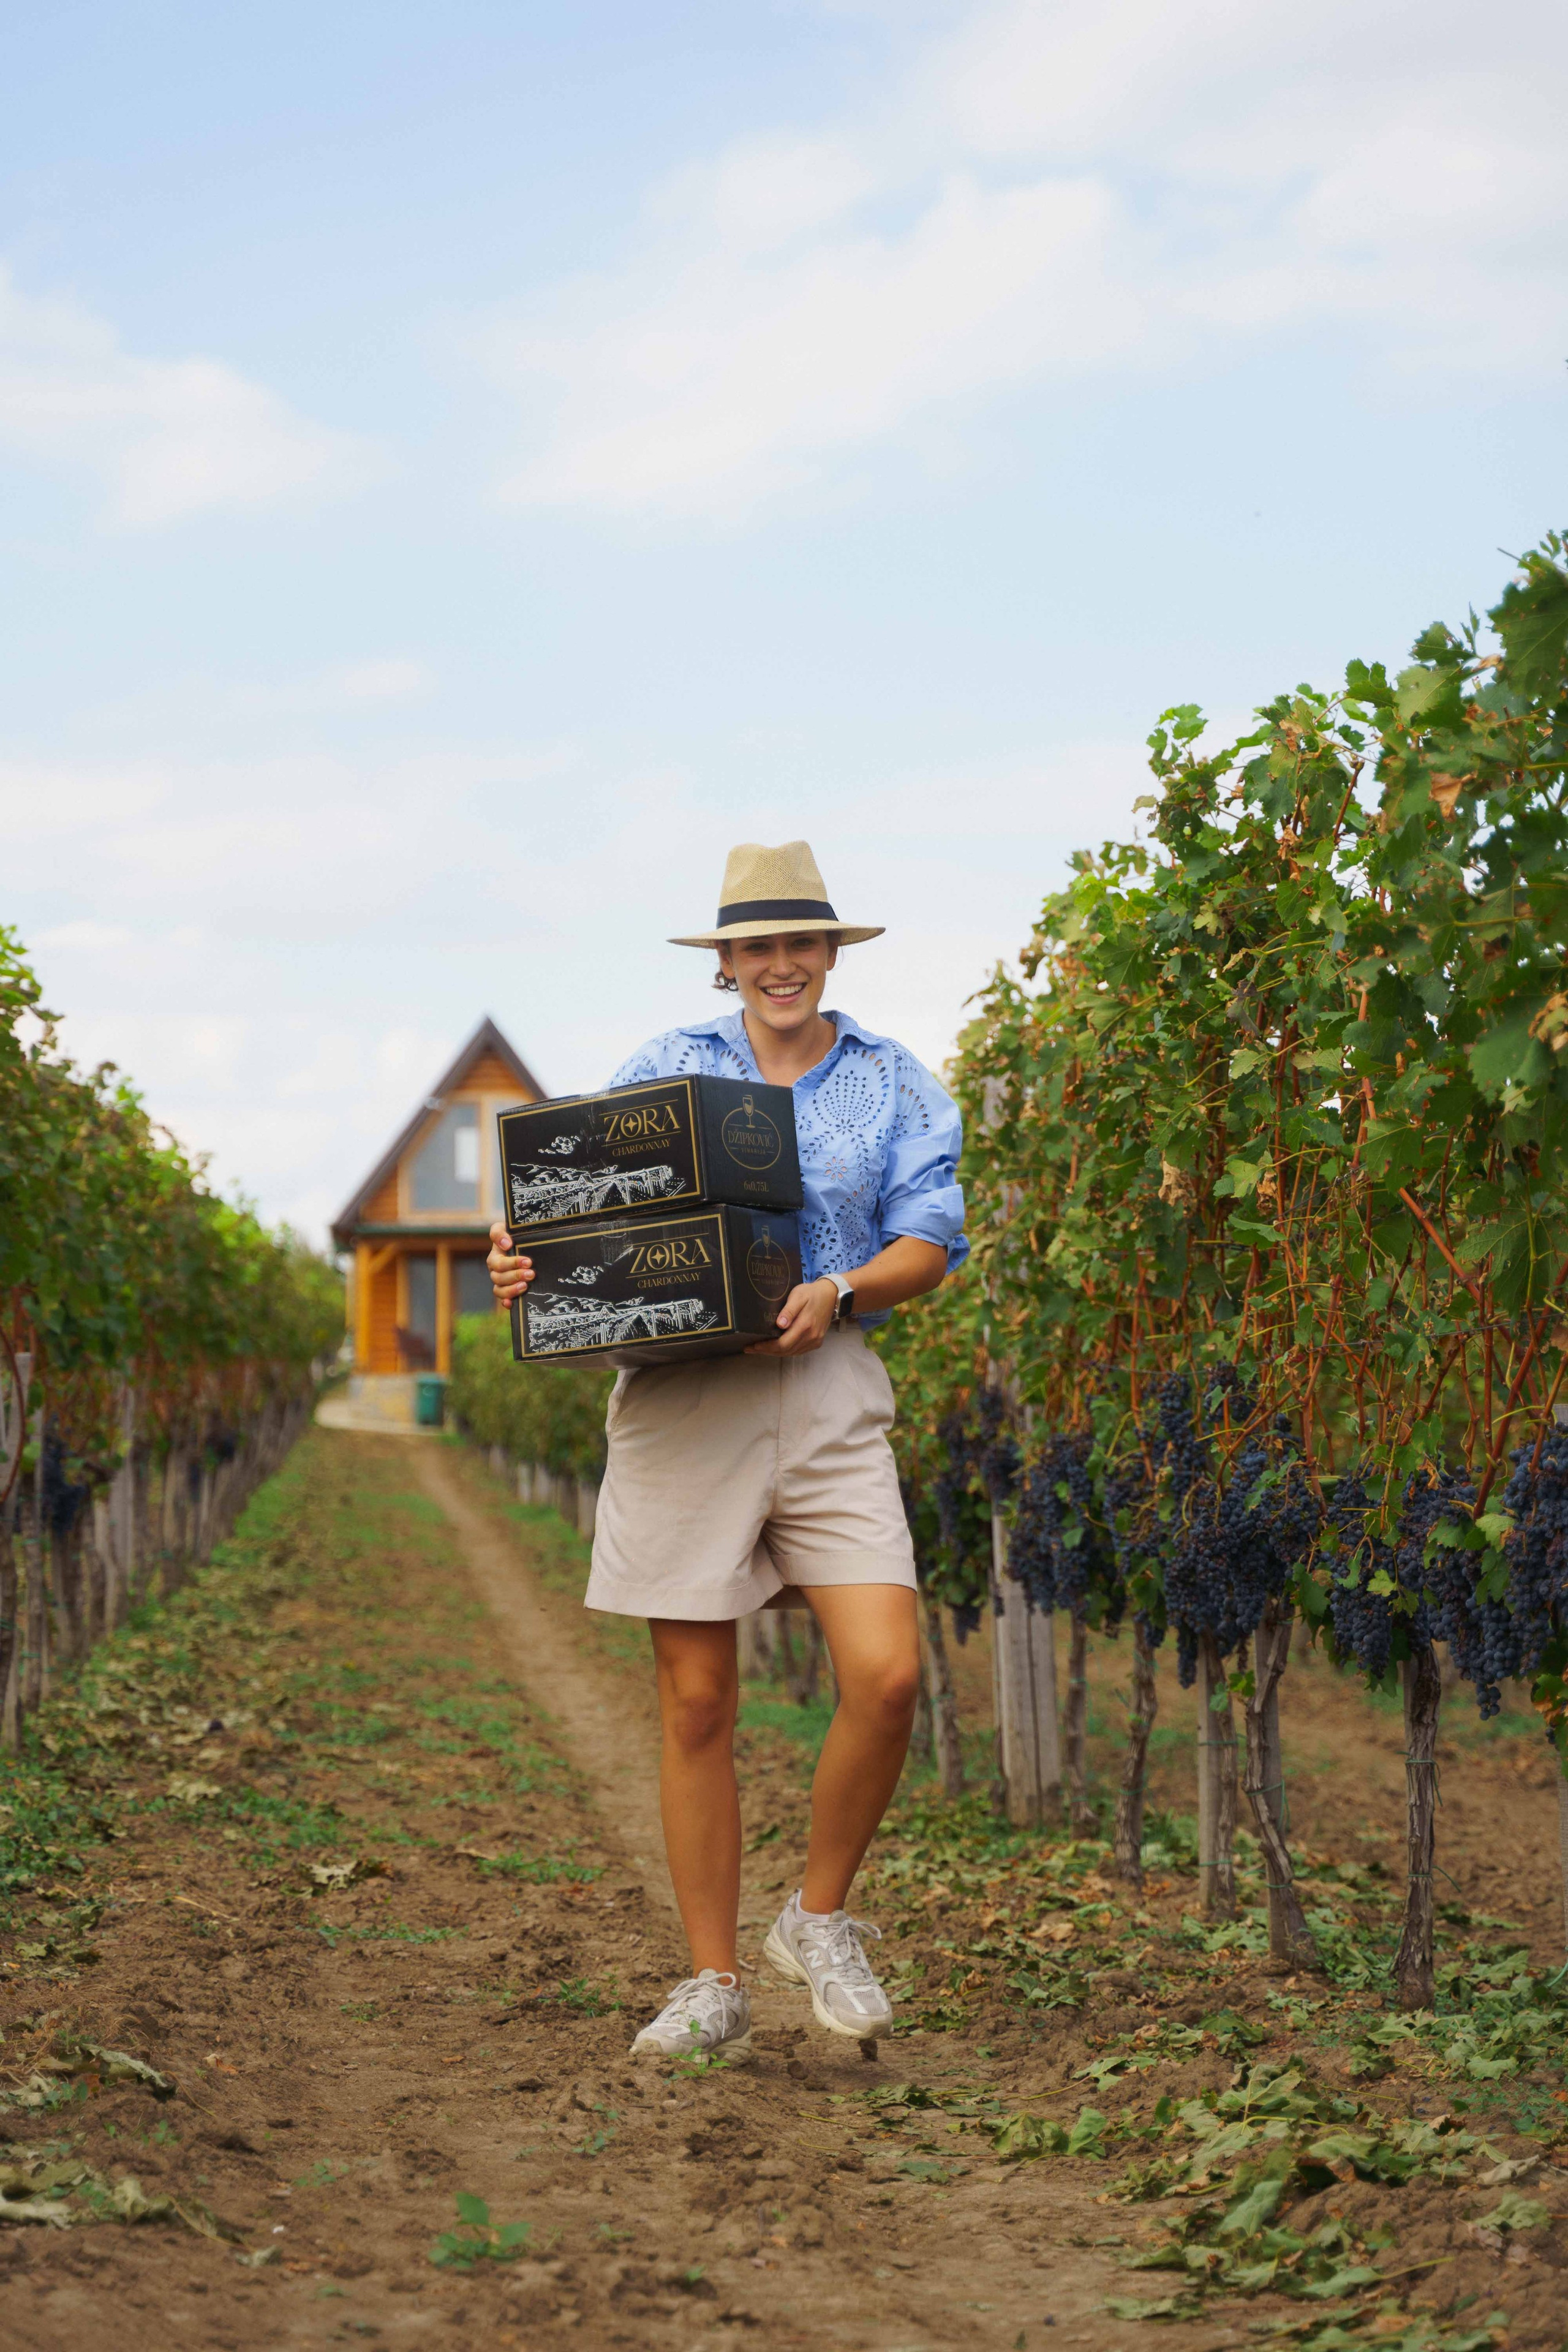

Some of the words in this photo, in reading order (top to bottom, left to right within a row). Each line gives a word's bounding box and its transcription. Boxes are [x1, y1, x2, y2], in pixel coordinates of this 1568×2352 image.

[603, 1105, 680, 1142] ZORA
[612, 1138, 671, 1157] CHARDONNAY
[727, 1129, 774, 1147] DŽIPKOVIĆ
[628, 1238, 712, 1273] ZORA
[638, 1272, 701, 1289] CHARDONNAY
